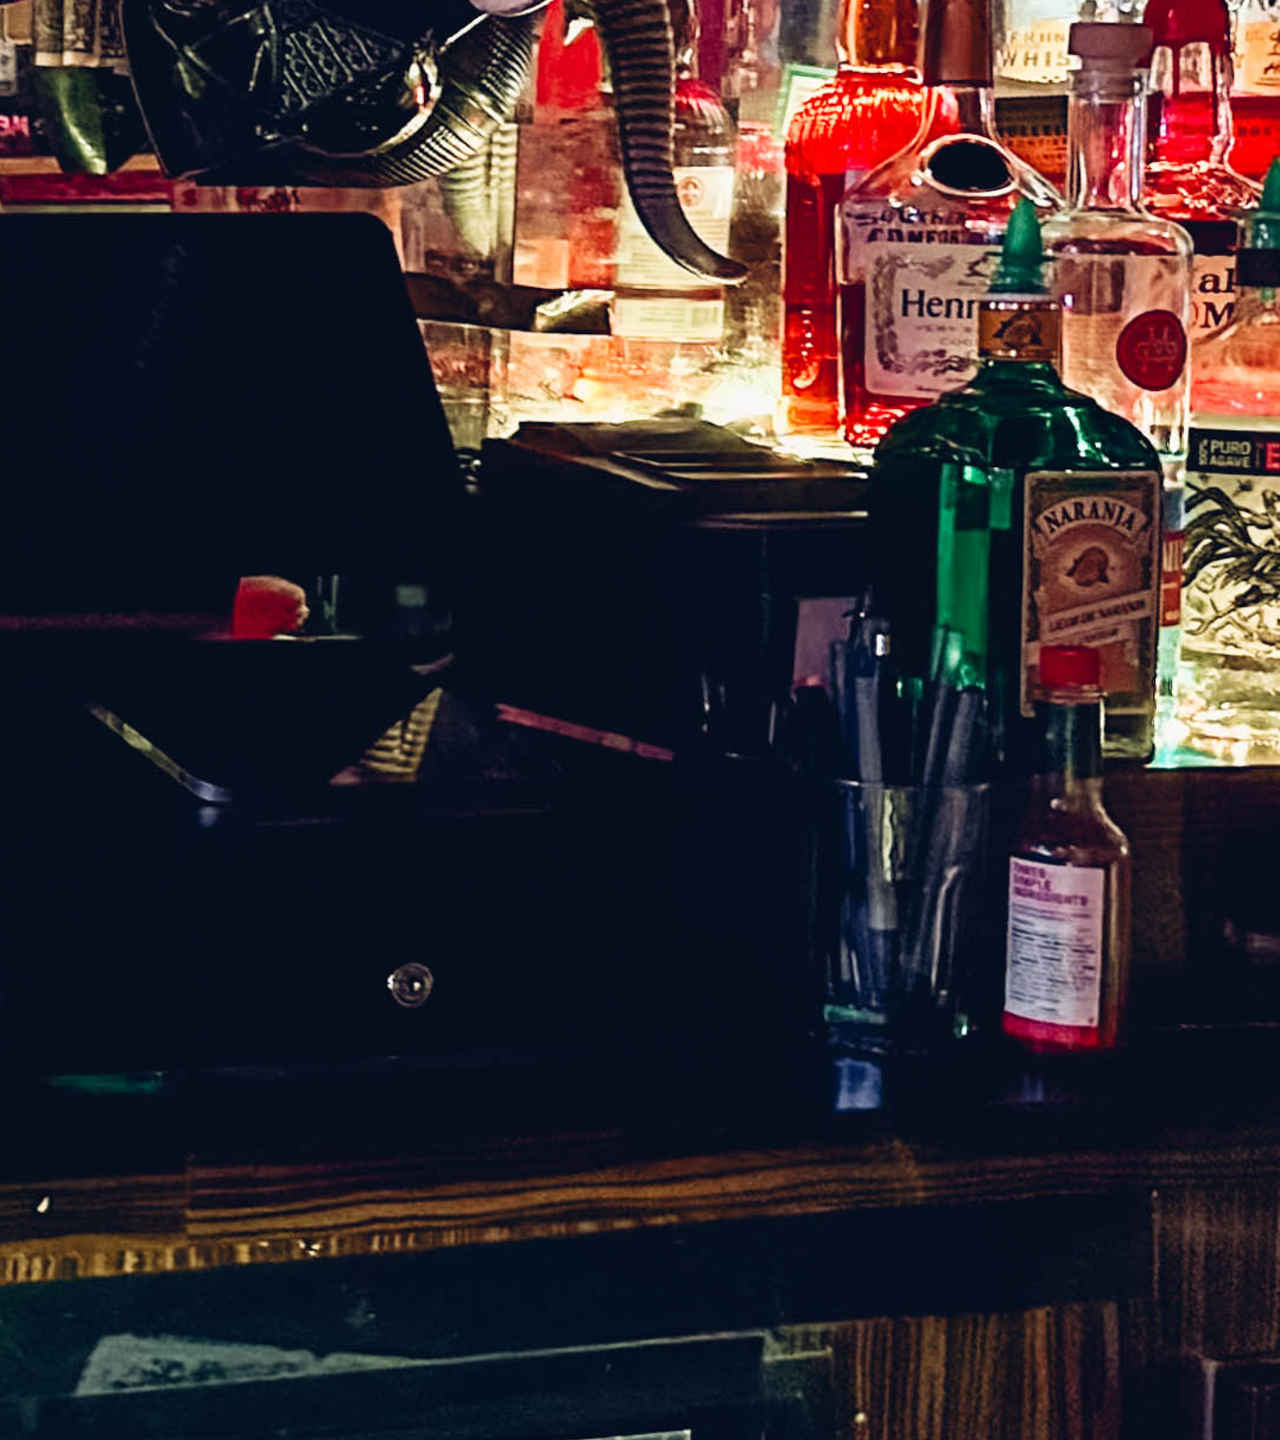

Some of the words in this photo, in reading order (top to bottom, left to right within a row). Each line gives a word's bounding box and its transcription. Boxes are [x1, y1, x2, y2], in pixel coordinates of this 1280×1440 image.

[902, 288, 976, 319] Henn
[1210, 440, 1251, 455] PURO
[1043, 502, 1135, 533] NARANJA
